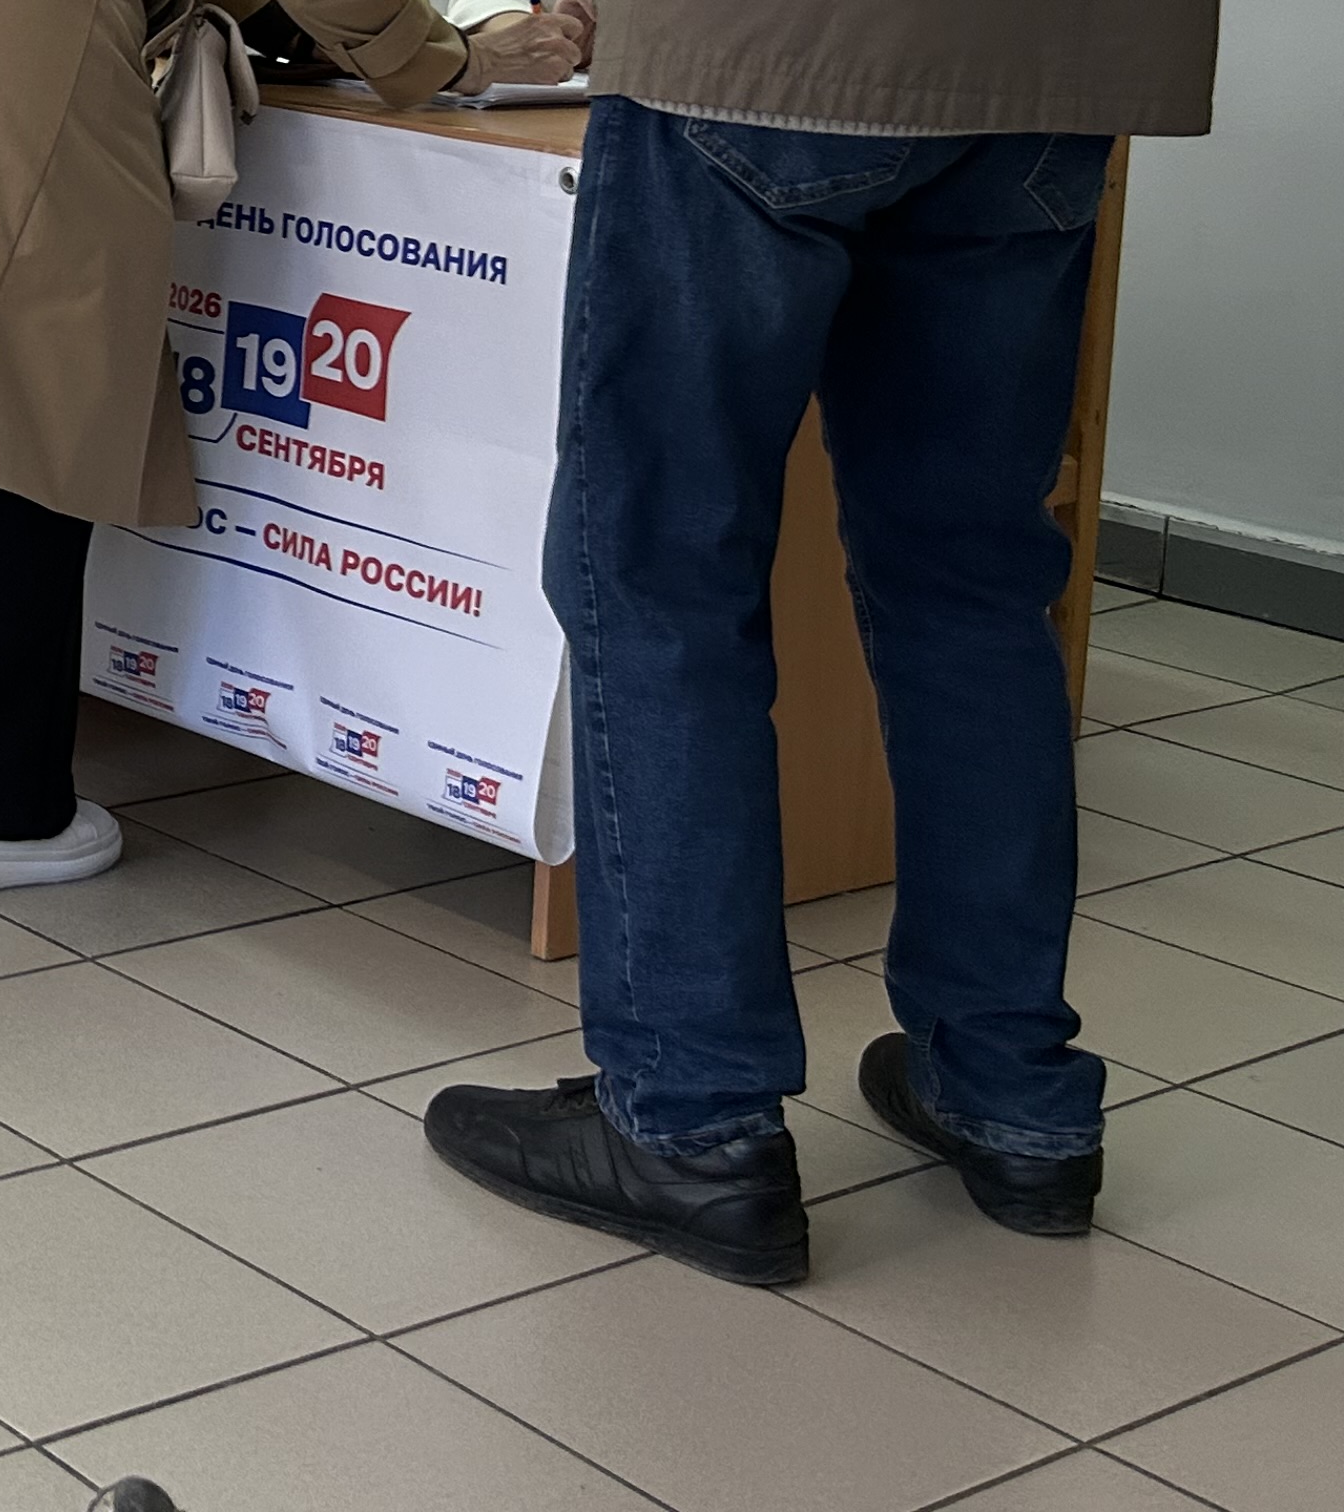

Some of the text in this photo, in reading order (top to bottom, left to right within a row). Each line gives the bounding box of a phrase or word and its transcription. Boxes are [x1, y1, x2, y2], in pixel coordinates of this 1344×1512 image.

[282, 213, 508, 285] ГОЛОСОВАНИЯ
[169, 283, 222, 319] 2026
[236, 333, 297, 398] 19
[311, 320, 382, 390] 20
[236, 424, 385, 490] СЕНТЯБРЯ
[263, 523, 333, 571] СИЛА
[341, 548, 484, 617] РОССИИ!
[139, 656, 155, 671] 20
[248, 693, 265, 708] 20
[361, 736, 377, 752] 20
[478, 782, 496, 799] 20
